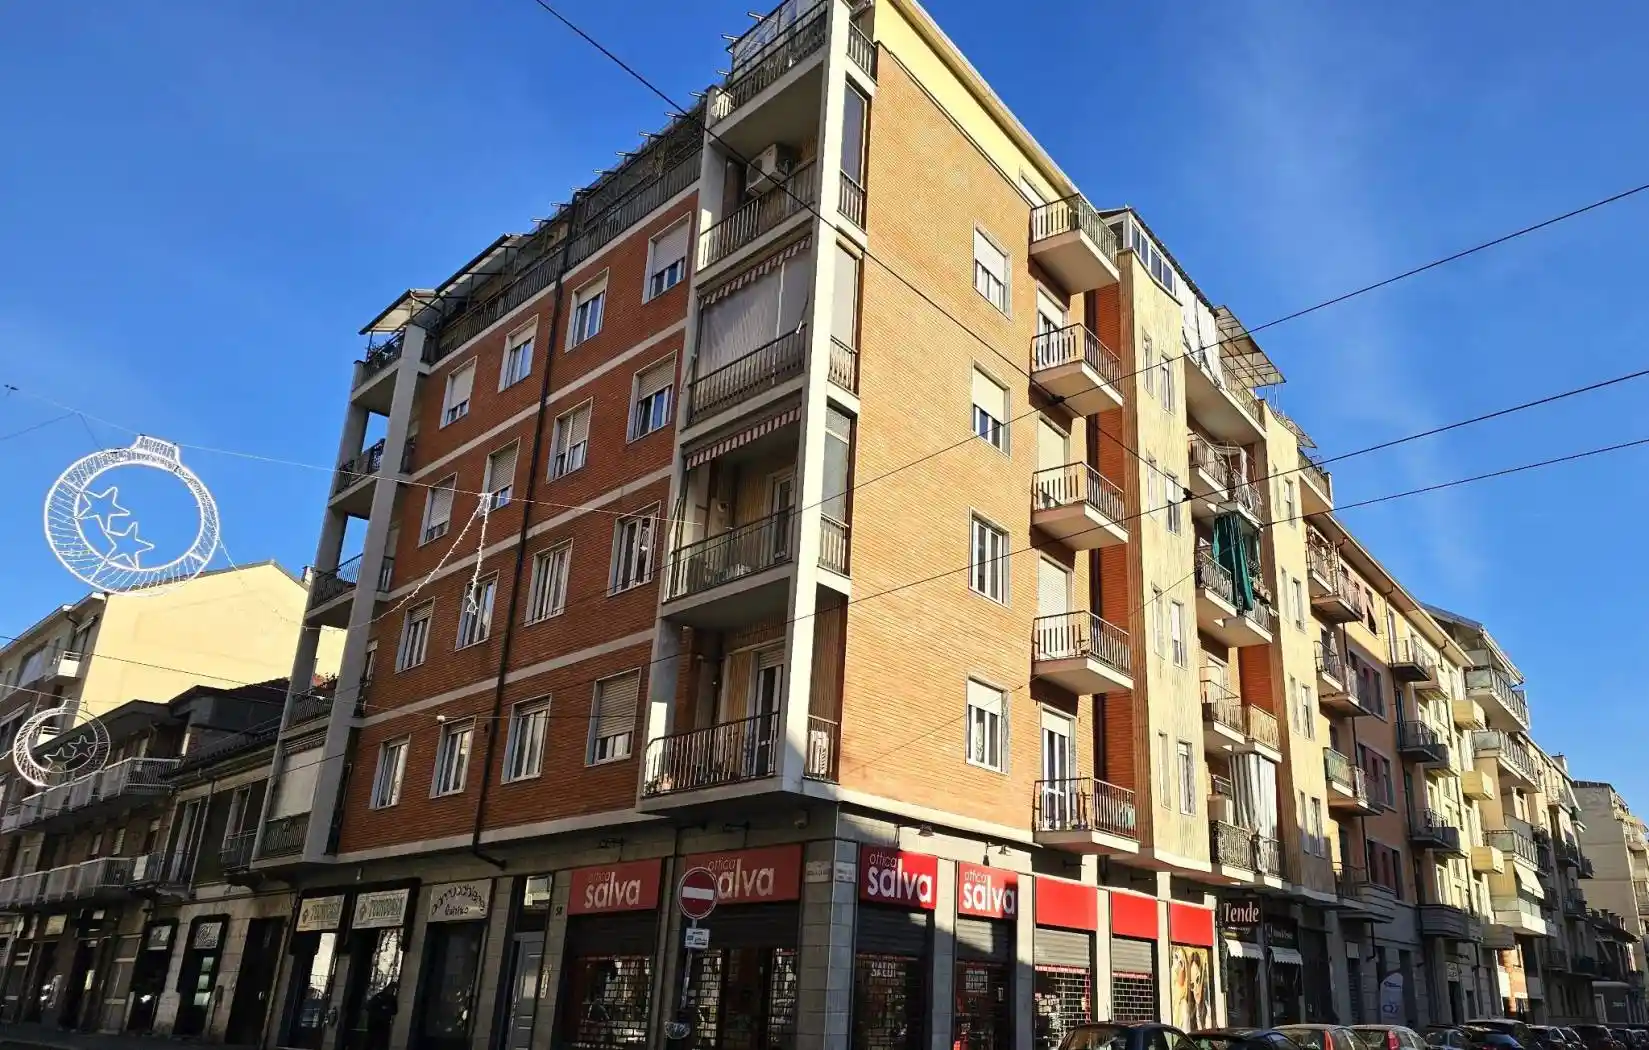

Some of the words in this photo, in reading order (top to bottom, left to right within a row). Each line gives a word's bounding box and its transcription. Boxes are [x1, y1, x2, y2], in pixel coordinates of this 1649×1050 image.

[707, 857, 736, 872] ottica
[869, 851, 897, 868] ottica
[584, 872, 641, 908] salva
[717, 859, 775, 898] alva
[868, 858, 932, 902] salva
[963, 874, 1015, 914] salva
[1223, 900, 1260, 923] Tende
